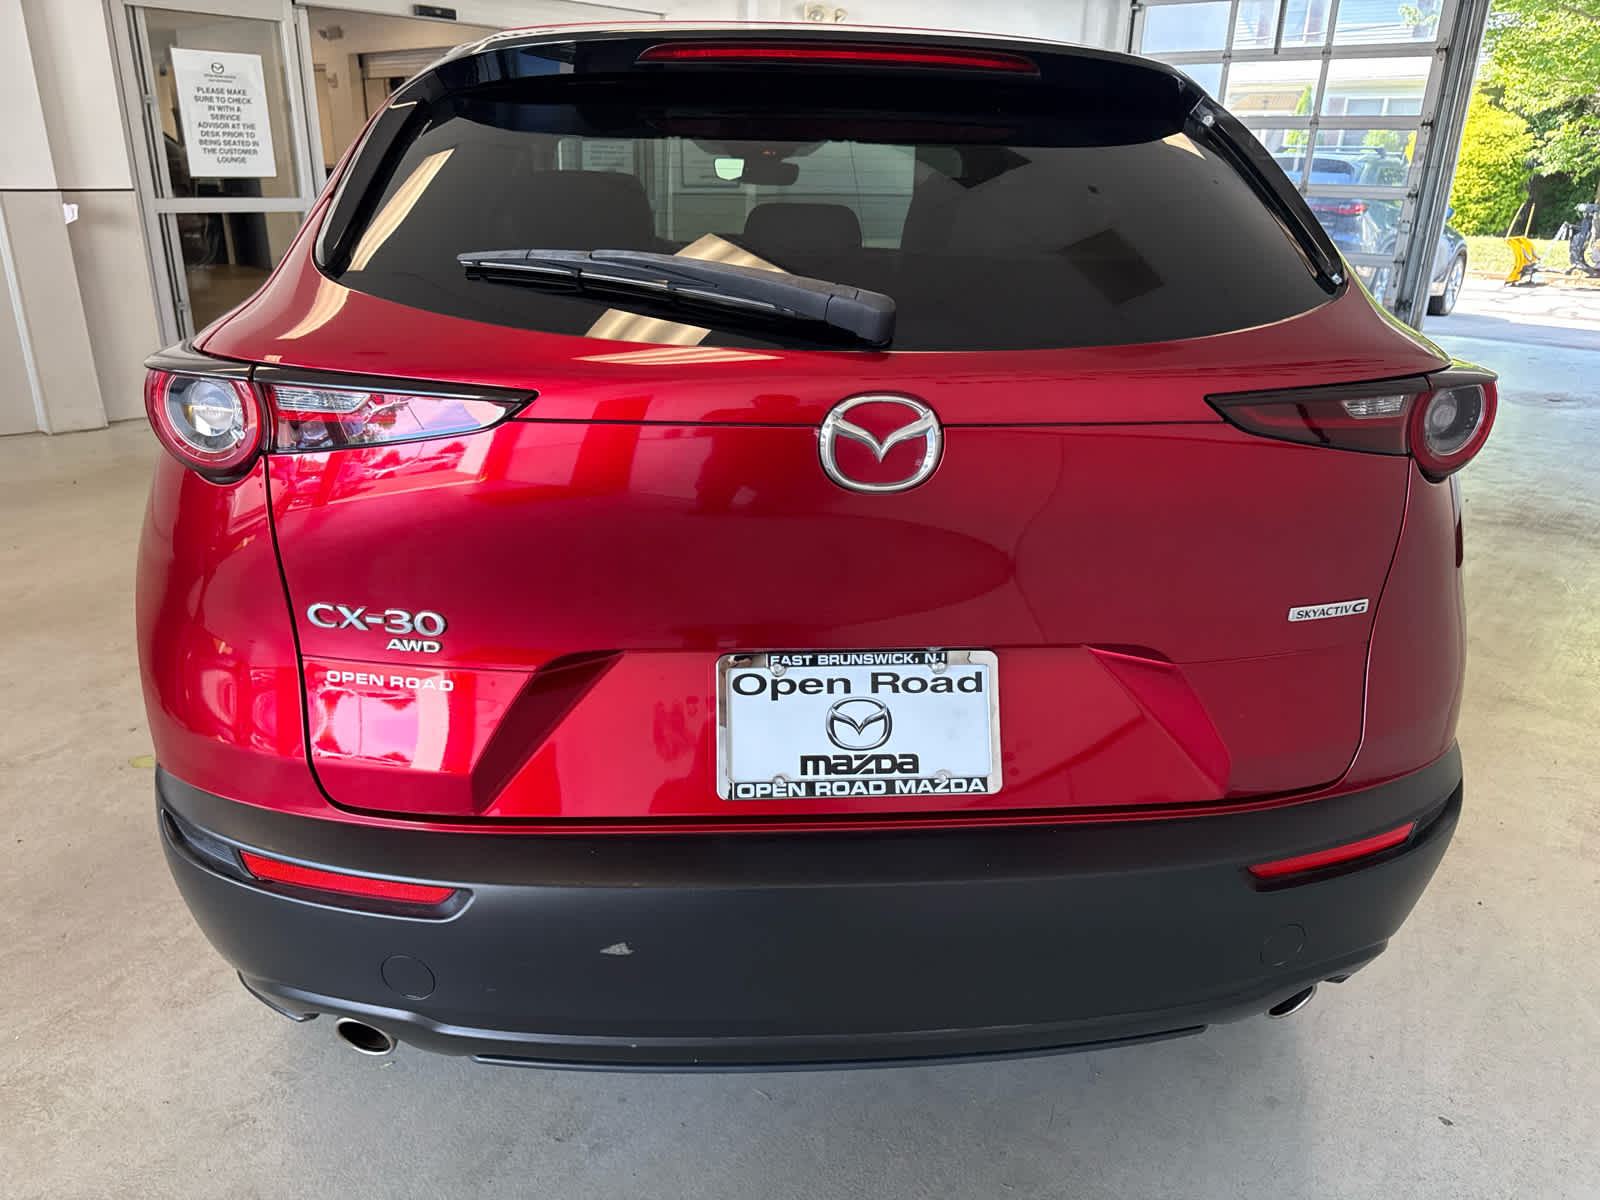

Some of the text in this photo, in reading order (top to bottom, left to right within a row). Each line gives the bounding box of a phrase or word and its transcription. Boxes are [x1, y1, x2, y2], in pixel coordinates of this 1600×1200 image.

[197, 87, 247, 96] PLEASE MAKE
[194, 95, 213, 103] SURE
[227, 96, 252, 104] CHECK
[217, 105, 235, 113] WITH
[210, 113, 241, 121] SERVICE
[198, 121, 230, 130] ADVISOR
[231, 122, 241, 130] AT
[200, 130, 255, 139] DESK PRIOR TO
[223, 139, 251, 147] SEATED
[202, 147, 258, 155] THE CUSTOMER
[217, 156, 247, 164] LOUNGE
[306, 602, 447, 637] CX-30
[386, 638, 442, 654] AWD
[817, 653, 919, 665] BRUNSWICK,
[326, 670, 455, 692] OPEN ROAD
[731, 671, 983, 701] Open Road
[736, 776, 987, 799] OPEN ROAD MAZDA
